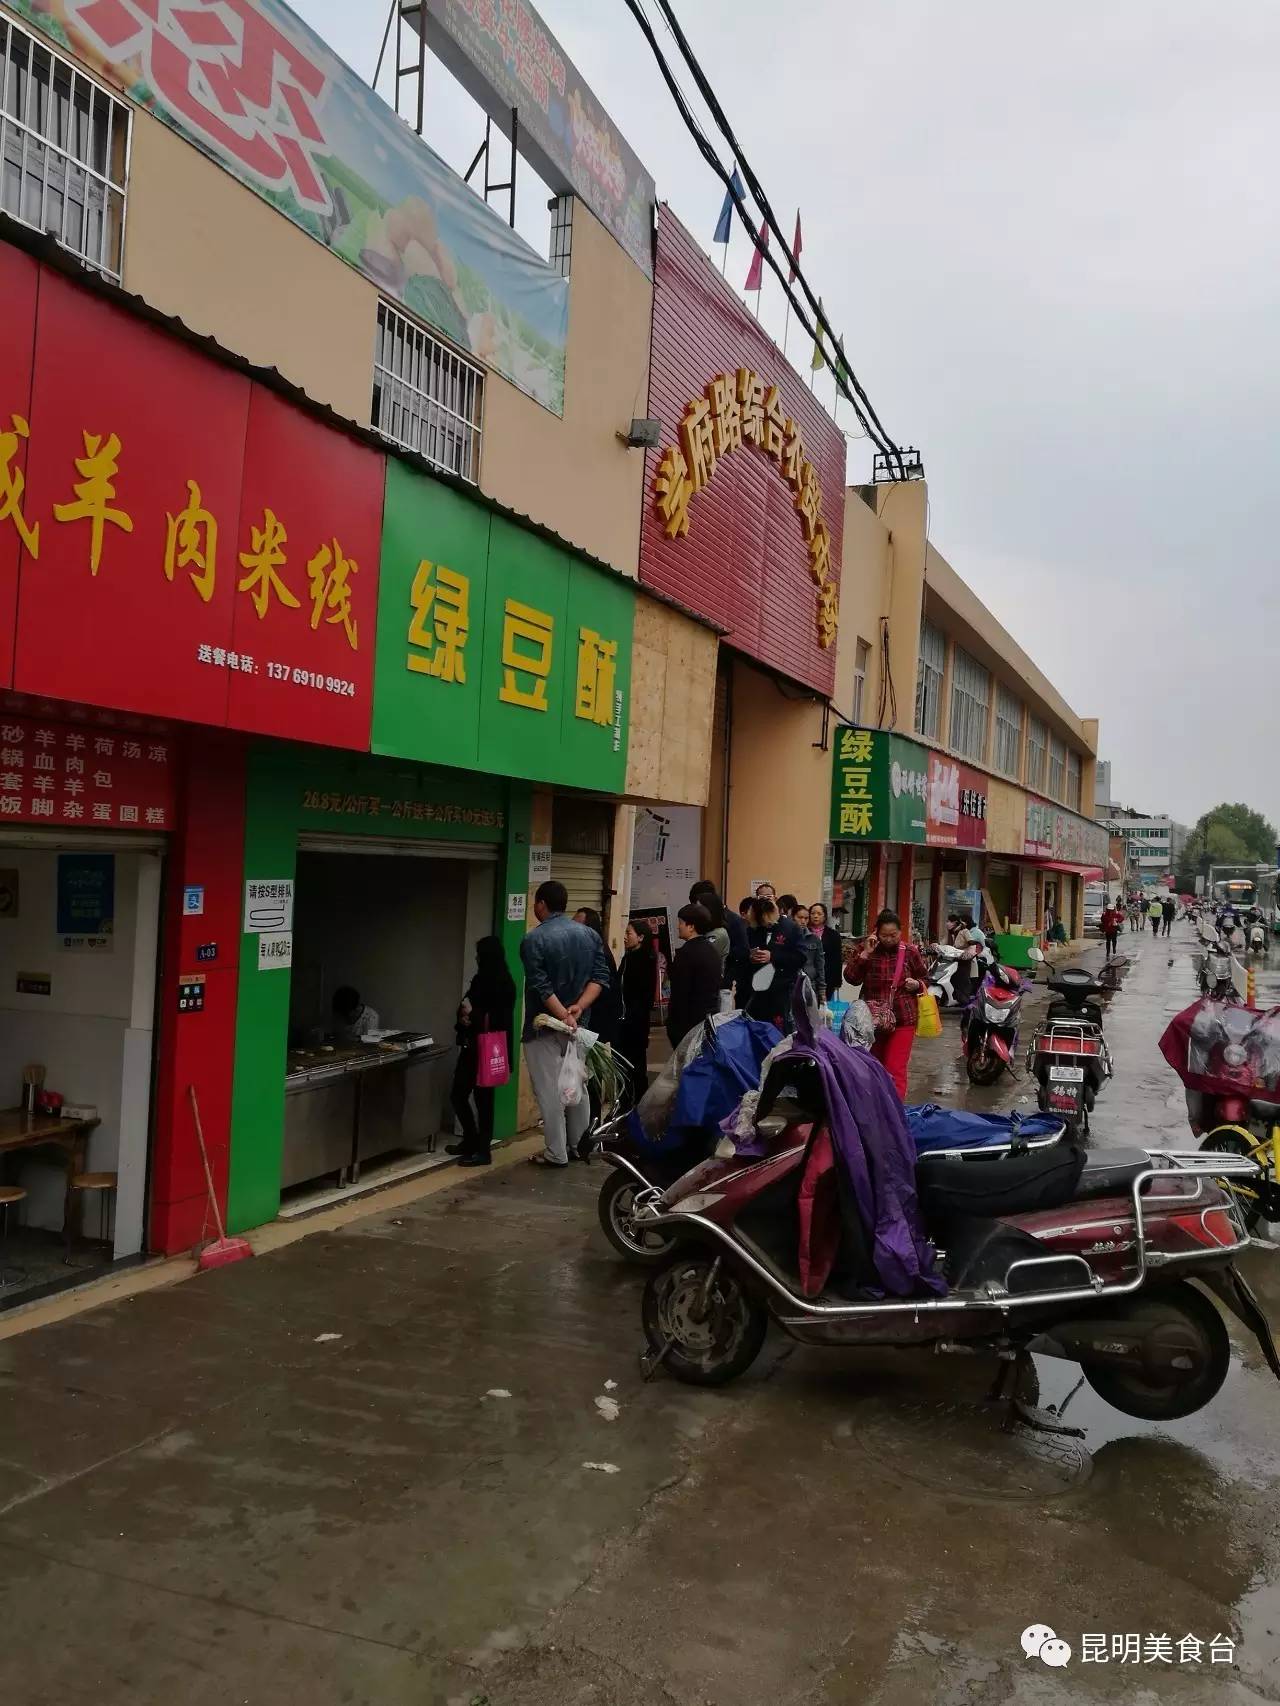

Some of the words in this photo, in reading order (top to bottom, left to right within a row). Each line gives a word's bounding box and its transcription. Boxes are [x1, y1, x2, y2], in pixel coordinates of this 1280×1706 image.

[267, 662, 291, 681] 137
[293, 669, 324, 690] 6910
[326, 677, 356, 698] 9924
[407, 559, 618, 727] 绿豆酥
[0, 724, 24, 814] 砂锅套饭
[31, 729, 56, 817] 羊血羊脚
[63, 733, 86, 818] 羊肉羊杂
[92, 737, 115, 821] 荷包蛋
[119, 740, 142, 823] 汤圆
[145, 745, 168, 824] 凉糕
[839, 728, 874, 836] 绿豆酥
[248, 884, 292, 899] 请按S型排队
